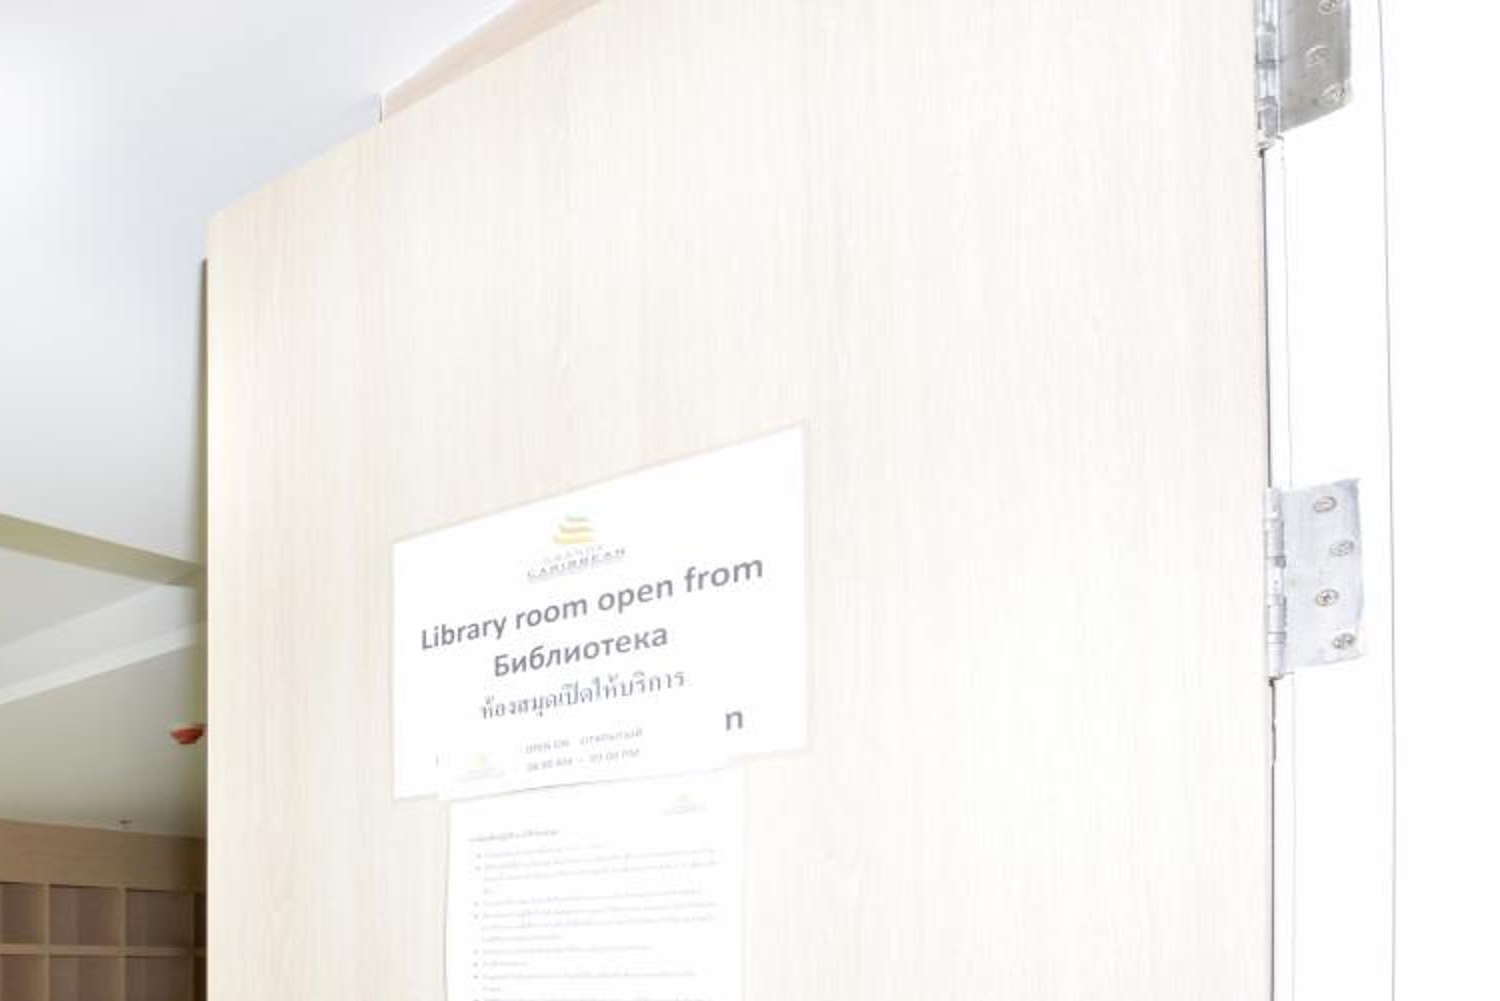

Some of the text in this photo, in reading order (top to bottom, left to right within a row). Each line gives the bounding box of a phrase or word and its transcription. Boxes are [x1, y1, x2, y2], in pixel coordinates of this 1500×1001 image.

[421, 559, 763, 651] Library room open from
[494, 627, 668, 678] Библиотека
